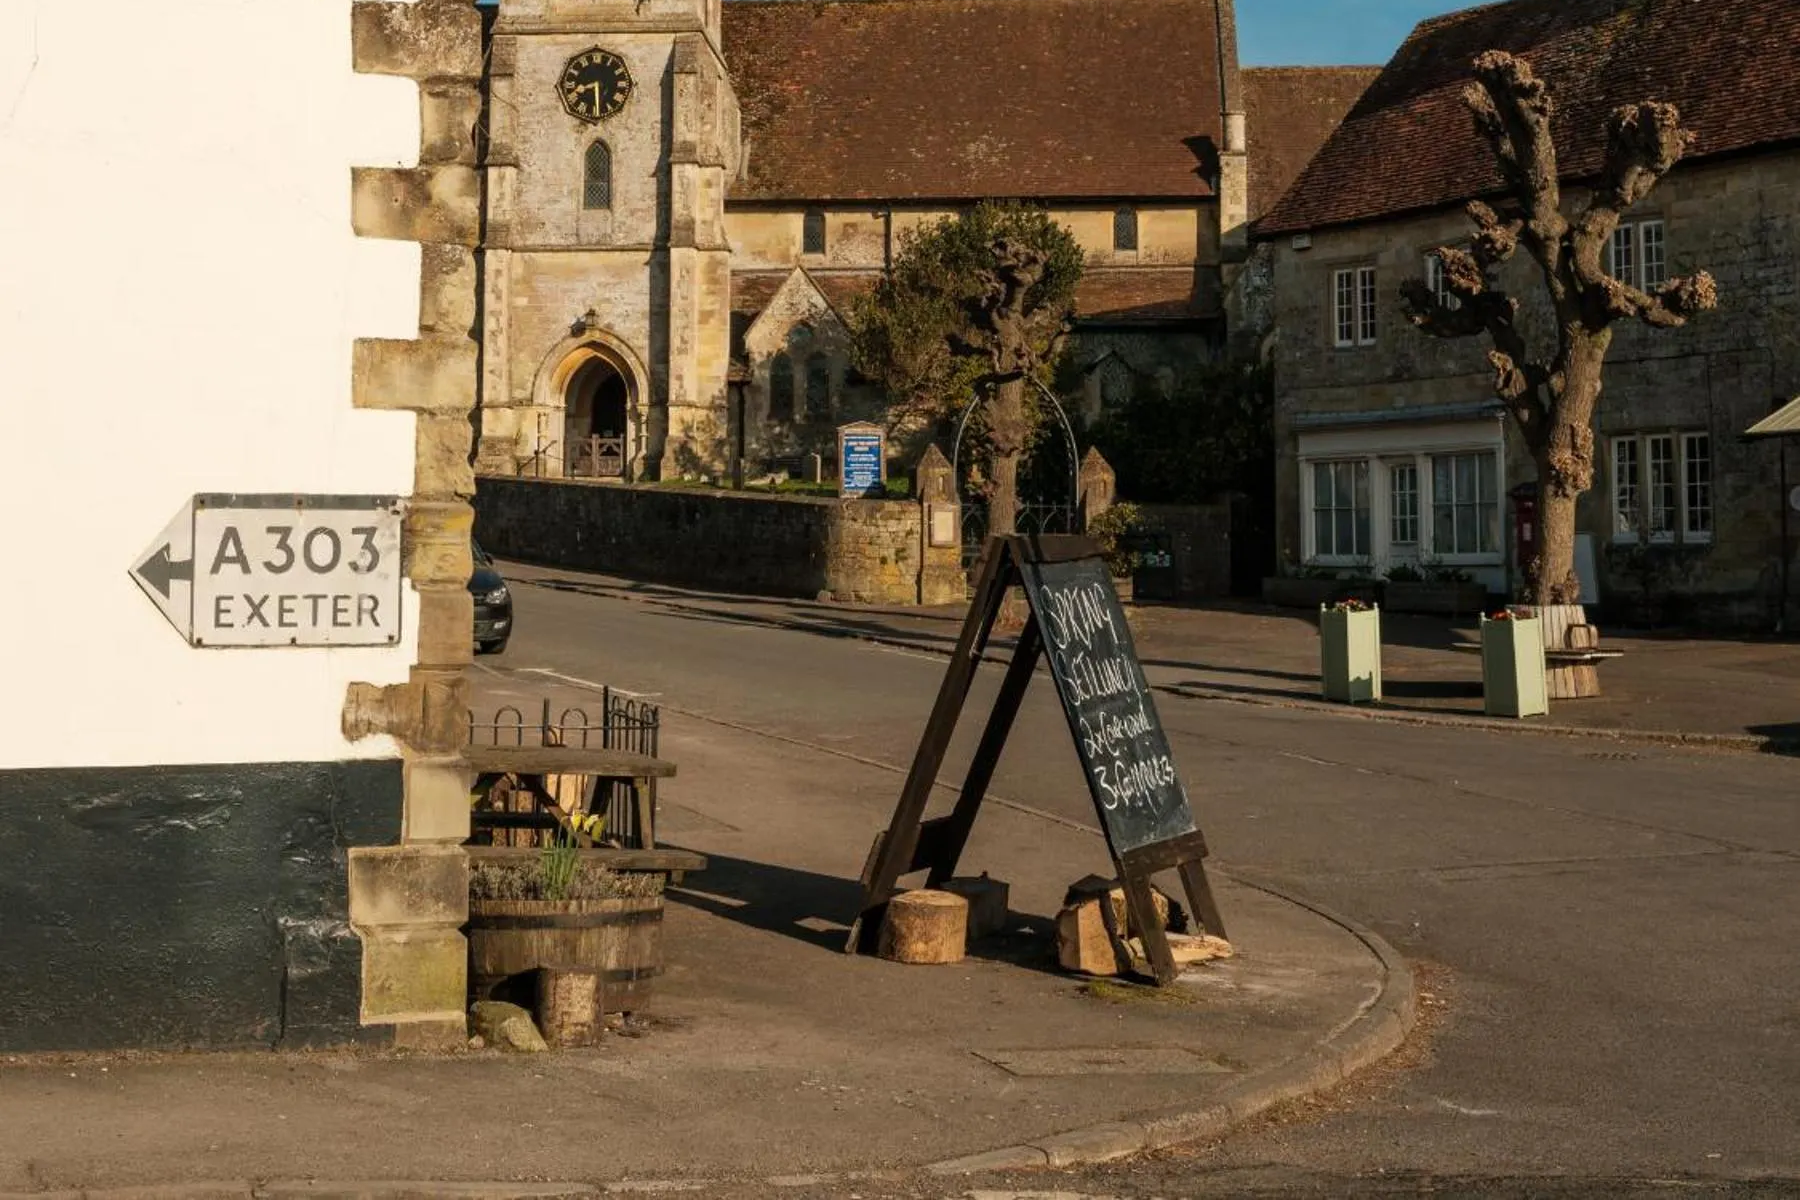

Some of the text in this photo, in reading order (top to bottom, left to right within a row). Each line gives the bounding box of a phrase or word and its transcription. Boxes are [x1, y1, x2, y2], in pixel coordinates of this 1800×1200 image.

[210, 526, 380, 575] A303
[214, 594, 381, 628] EXETER
[1041, 583, 1118, 650] SPRING
